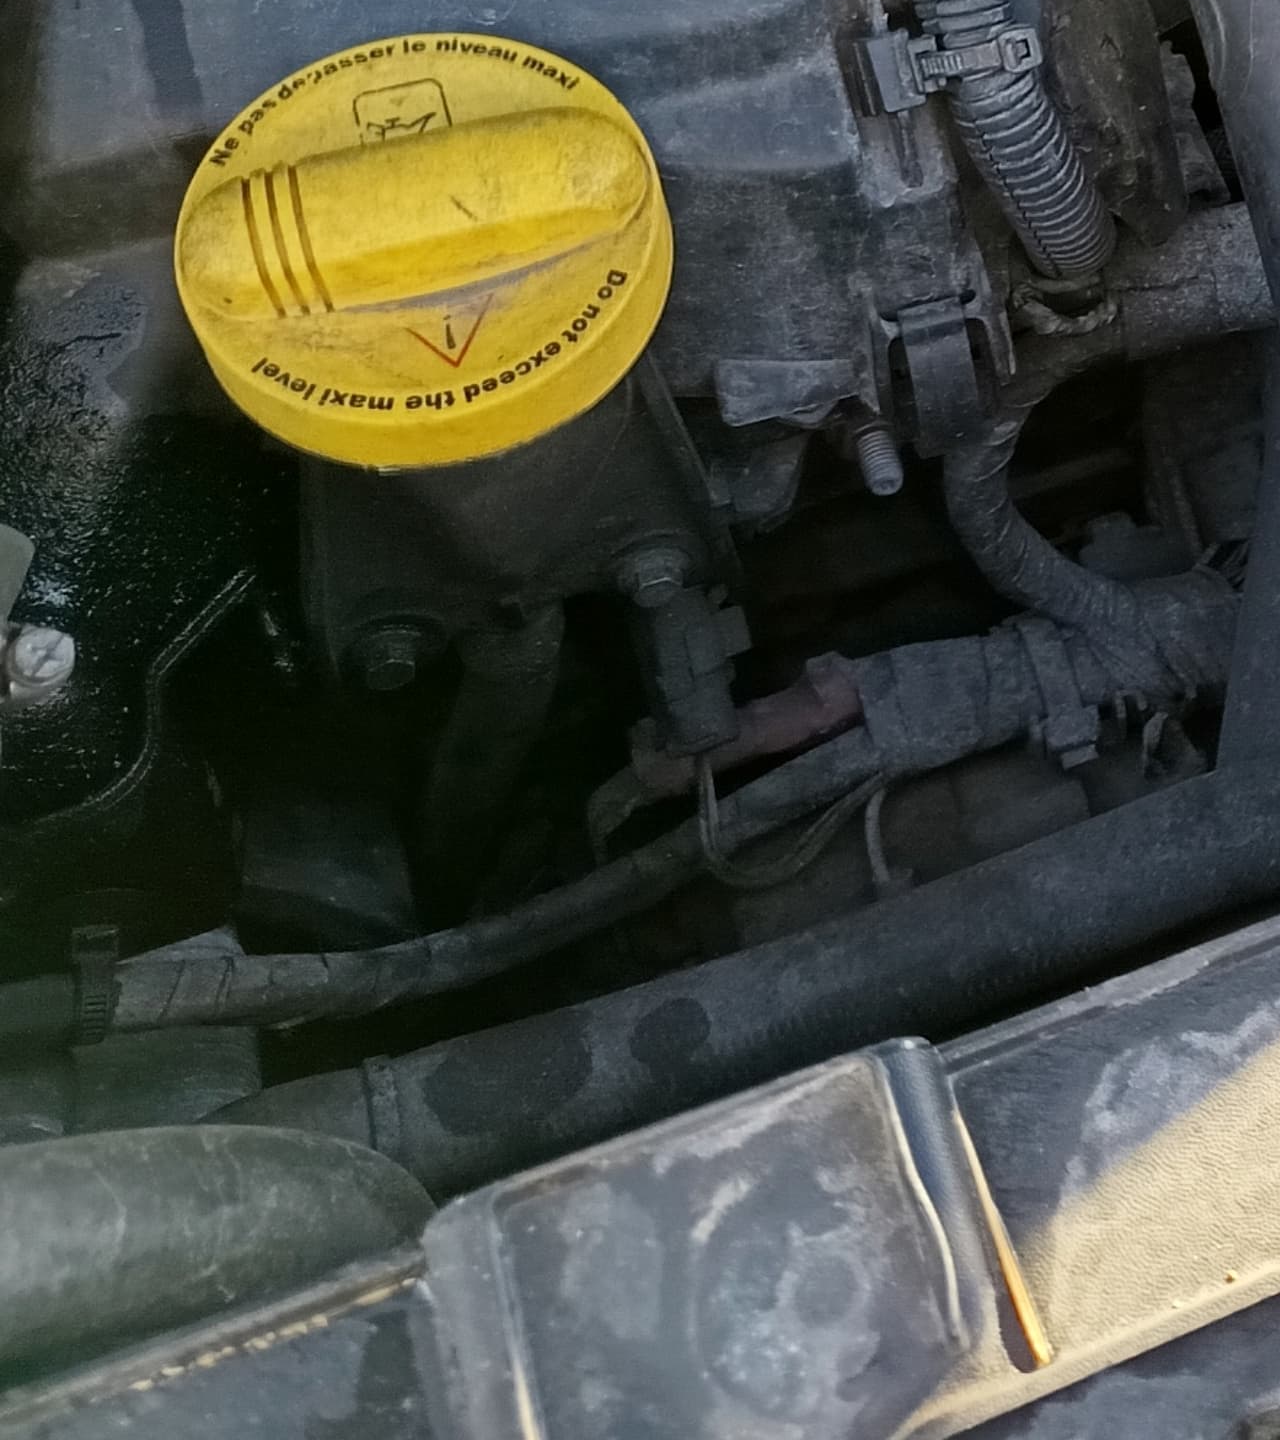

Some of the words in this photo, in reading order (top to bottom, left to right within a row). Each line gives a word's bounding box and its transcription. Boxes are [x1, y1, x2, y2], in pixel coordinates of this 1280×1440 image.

[208, 134, 241, 168] Ne
[239, 95, 279, 135] pas
[402, 38, 427, 55] le
[435, 36, 519, 64] niveau
[522, 54, 581, 92] maxi
[596, 268, 628, 303] Do
[562, 302, 600, 344] not
[251, 355, 318, 407] level
[464, 342, 563, 405] exceed
[317, 385, 395, 411] maxi
[405, 391, 456, 411] the
